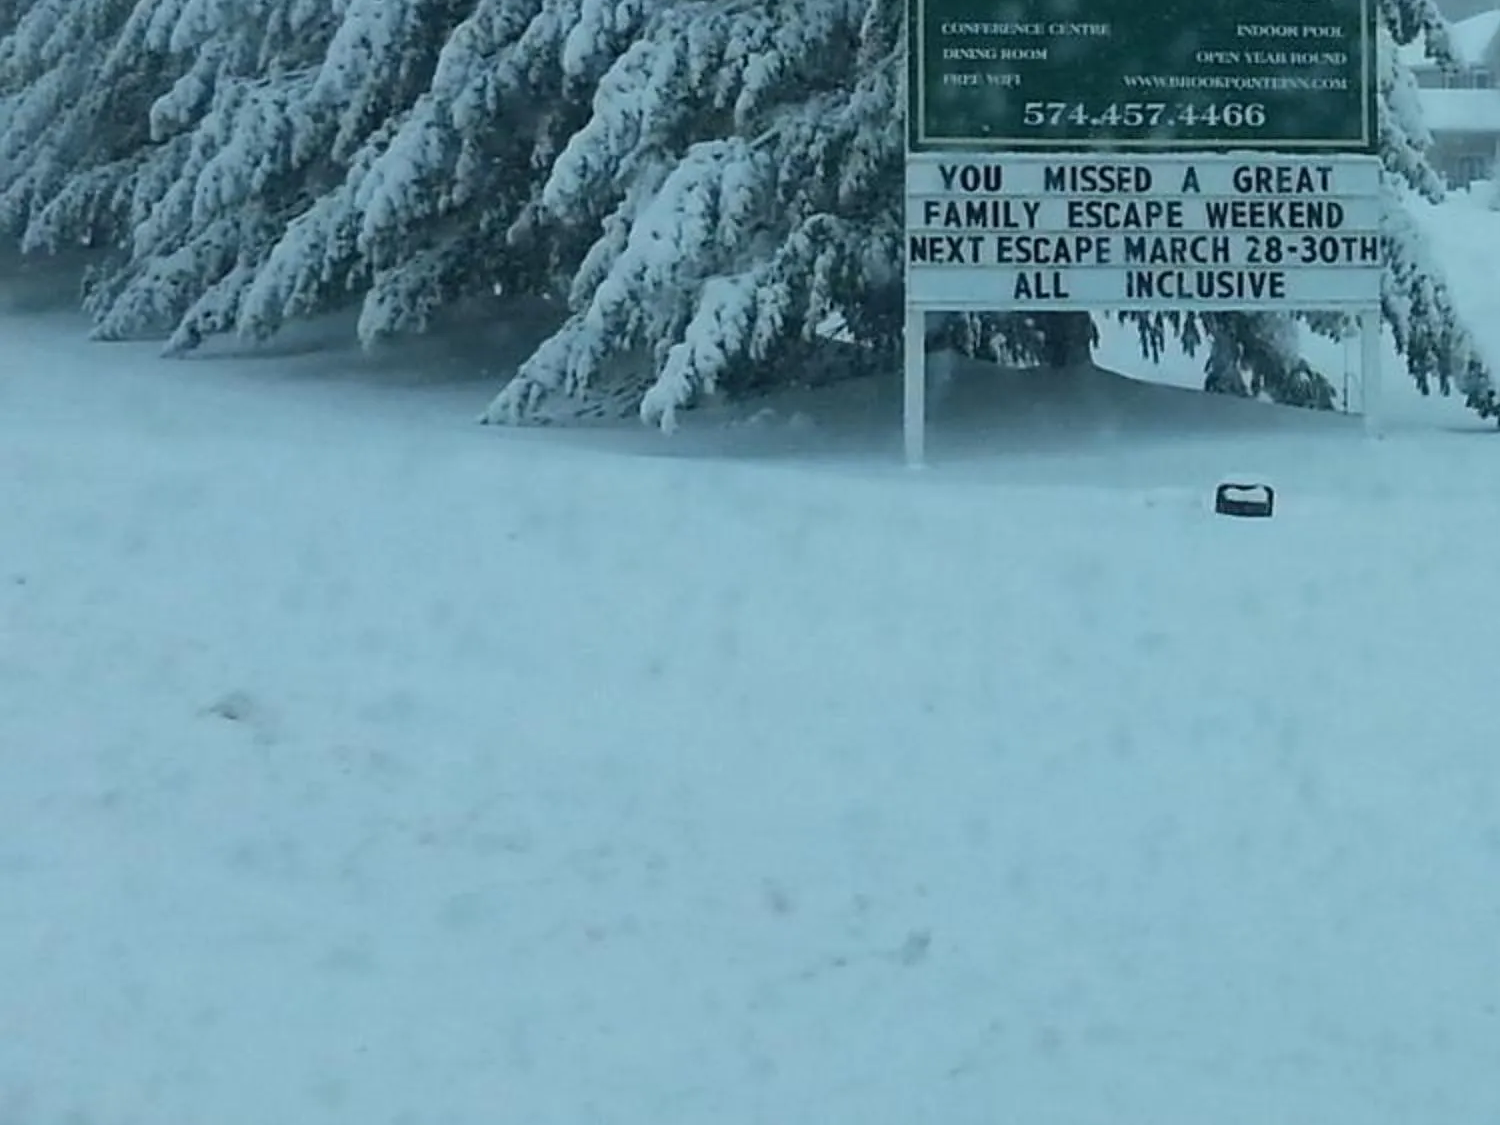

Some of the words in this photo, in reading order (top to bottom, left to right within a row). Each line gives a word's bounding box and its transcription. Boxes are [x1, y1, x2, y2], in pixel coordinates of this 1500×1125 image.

[941, 23, 1044, 35] CONFERENCE
[1237, 25, 1299, 37] INDOOR
[1303, 25, 1344, 37] POOL
[943, 48, 997, 60] DINING
[1001, 48, 1048, 60] ROOM
[1197, 52, 1240, 64] OPEN
[1244, 52, 1287, 64] YEAR
[1291, 52, 1348, 65] ROUND
[1024, 102, 1266, 126] 574.457.4466
[939, 165, 1002, 191] YOU
[1044, 166, 1152, 192] MISSED
[1181, 166, 1200, 192] A
[1233, 166, 1333, 192] GREAT
[924, 201, 1040, 227] FAMILY
[1068, 202, 1183, 228] ESCAPE
[1206, 202, 1344, 228] WEEKEND
[910, 236, 985, 263] NEXT
[997, 237, 1111, 263] ESCAPE
[1124, 236, 1230, 263] MARCH
[1245, 236, 1378, 263] 28-30TH
[1014, 272, 1069, 299] ALL
[1126, 271, 1286, 299] INCLUSIVE
